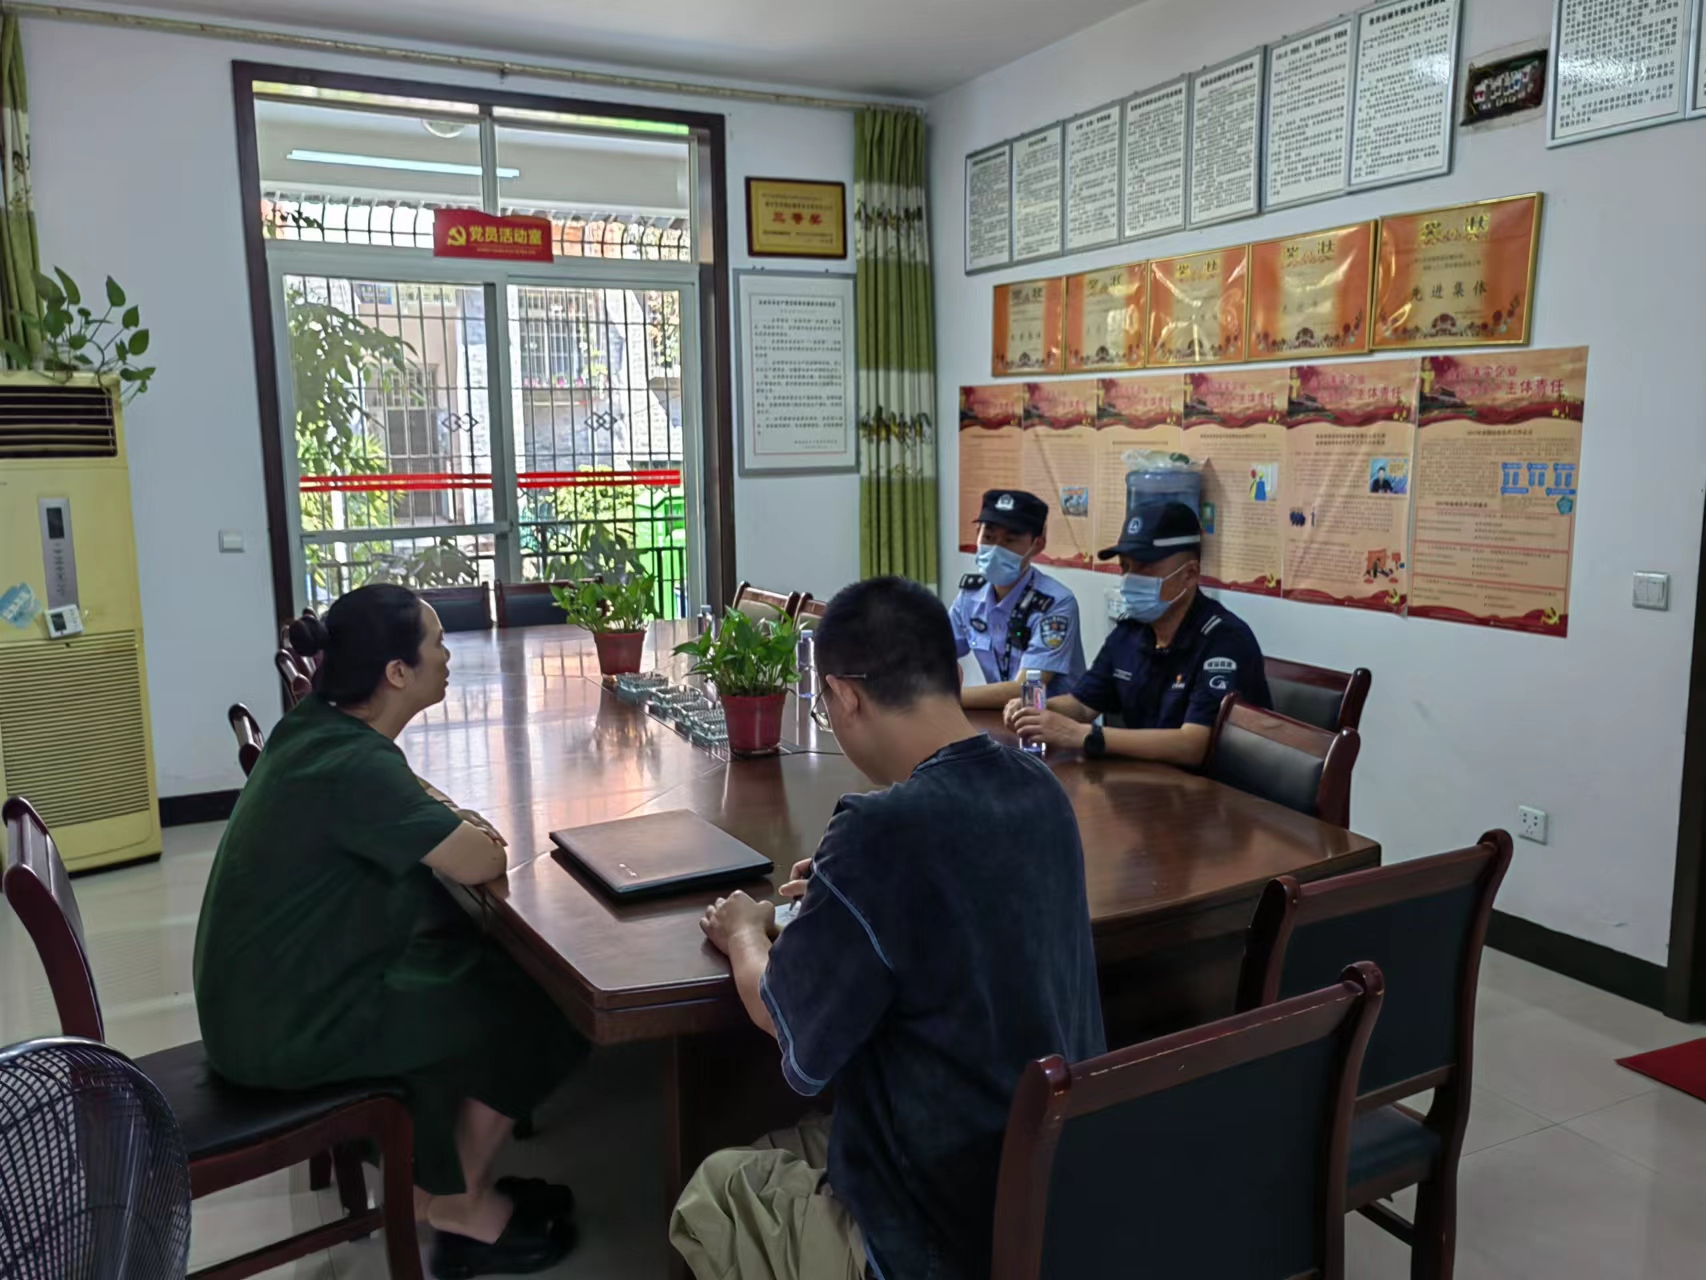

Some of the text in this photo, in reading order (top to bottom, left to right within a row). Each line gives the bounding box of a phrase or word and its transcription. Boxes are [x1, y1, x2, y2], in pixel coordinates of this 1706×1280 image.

[469, 225, 542, 245] 党员活动室
[1410, 280, 1488, 302] 先进集体
